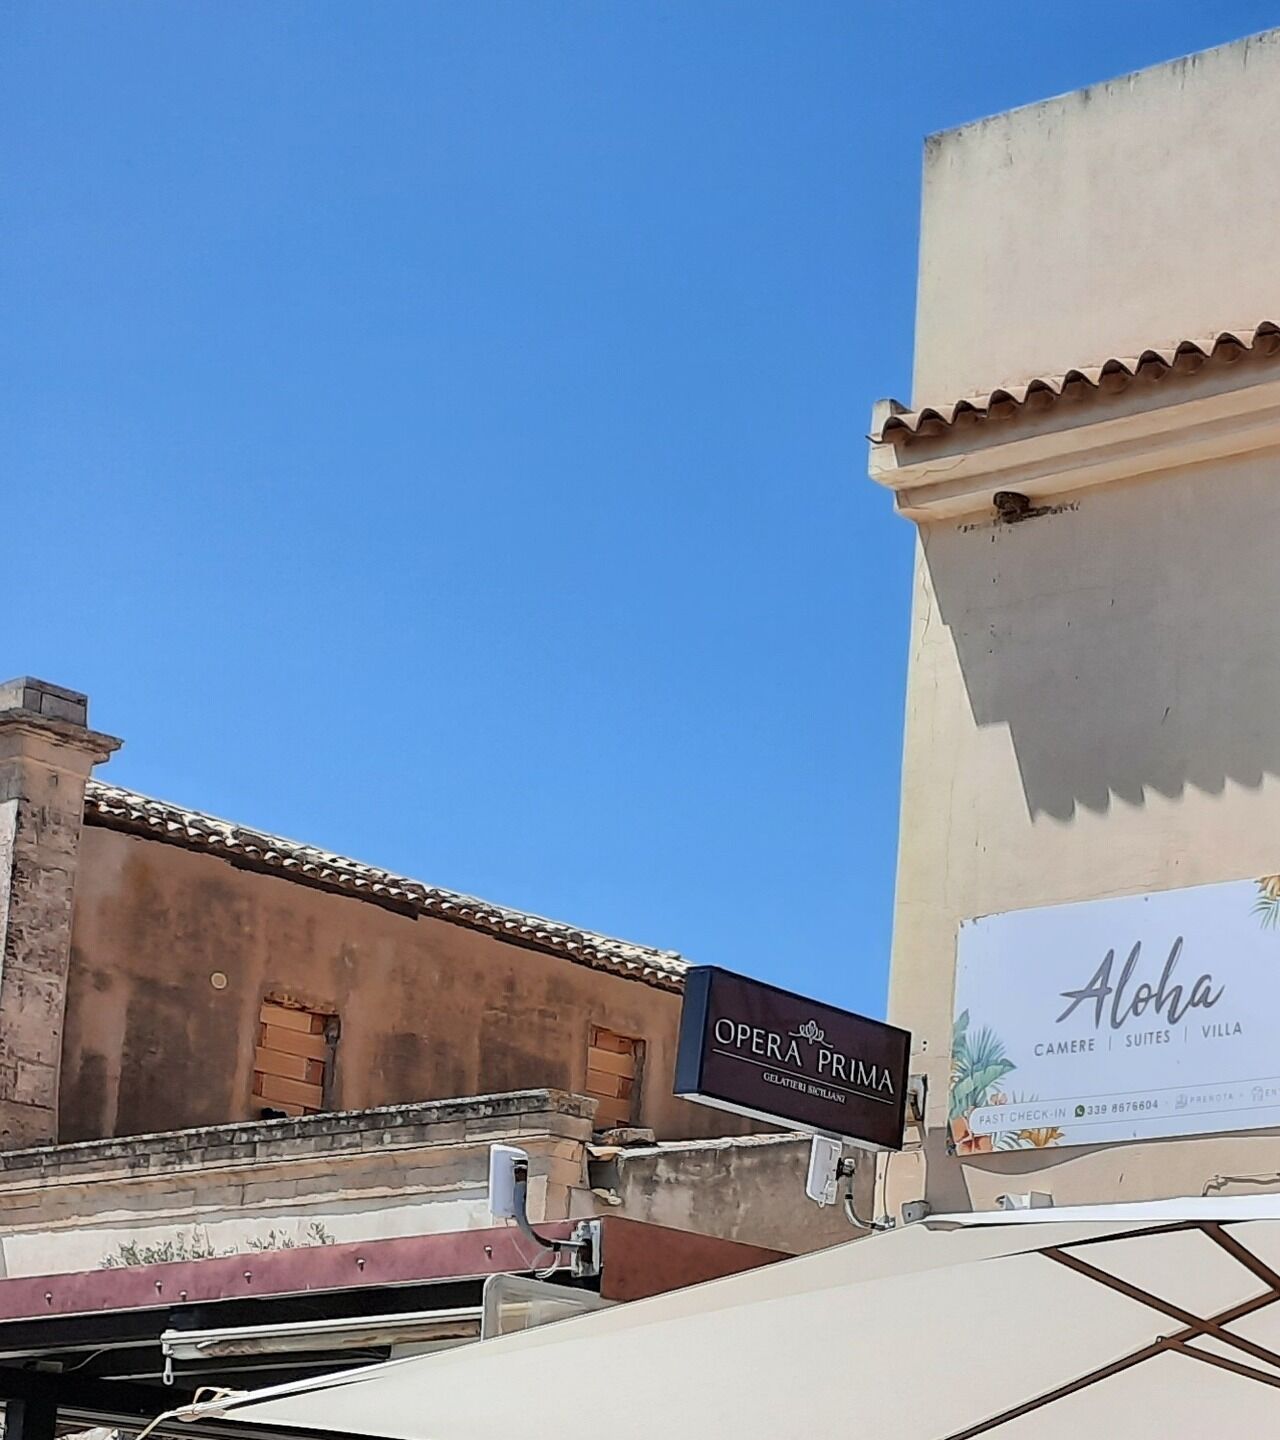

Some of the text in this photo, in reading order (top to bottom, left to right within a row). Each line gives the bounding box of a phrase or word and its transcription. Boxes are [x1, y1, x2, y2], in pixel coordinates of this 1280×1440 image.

[1055, 935, 1225, 1029] Aloha
[714, 1018, 894, 1094] OPERA PRIMA
[1034, 1021, 1242, 1056] CAMERE SUITES VILLA
[763, 1071, 806, 1093] GELATIERI
[979, 1113, 1005, 1125] FAST
[1010, 1107, 1066, 1122] CHECK-IN
[1087, 1104, 1107, 1115] 339
